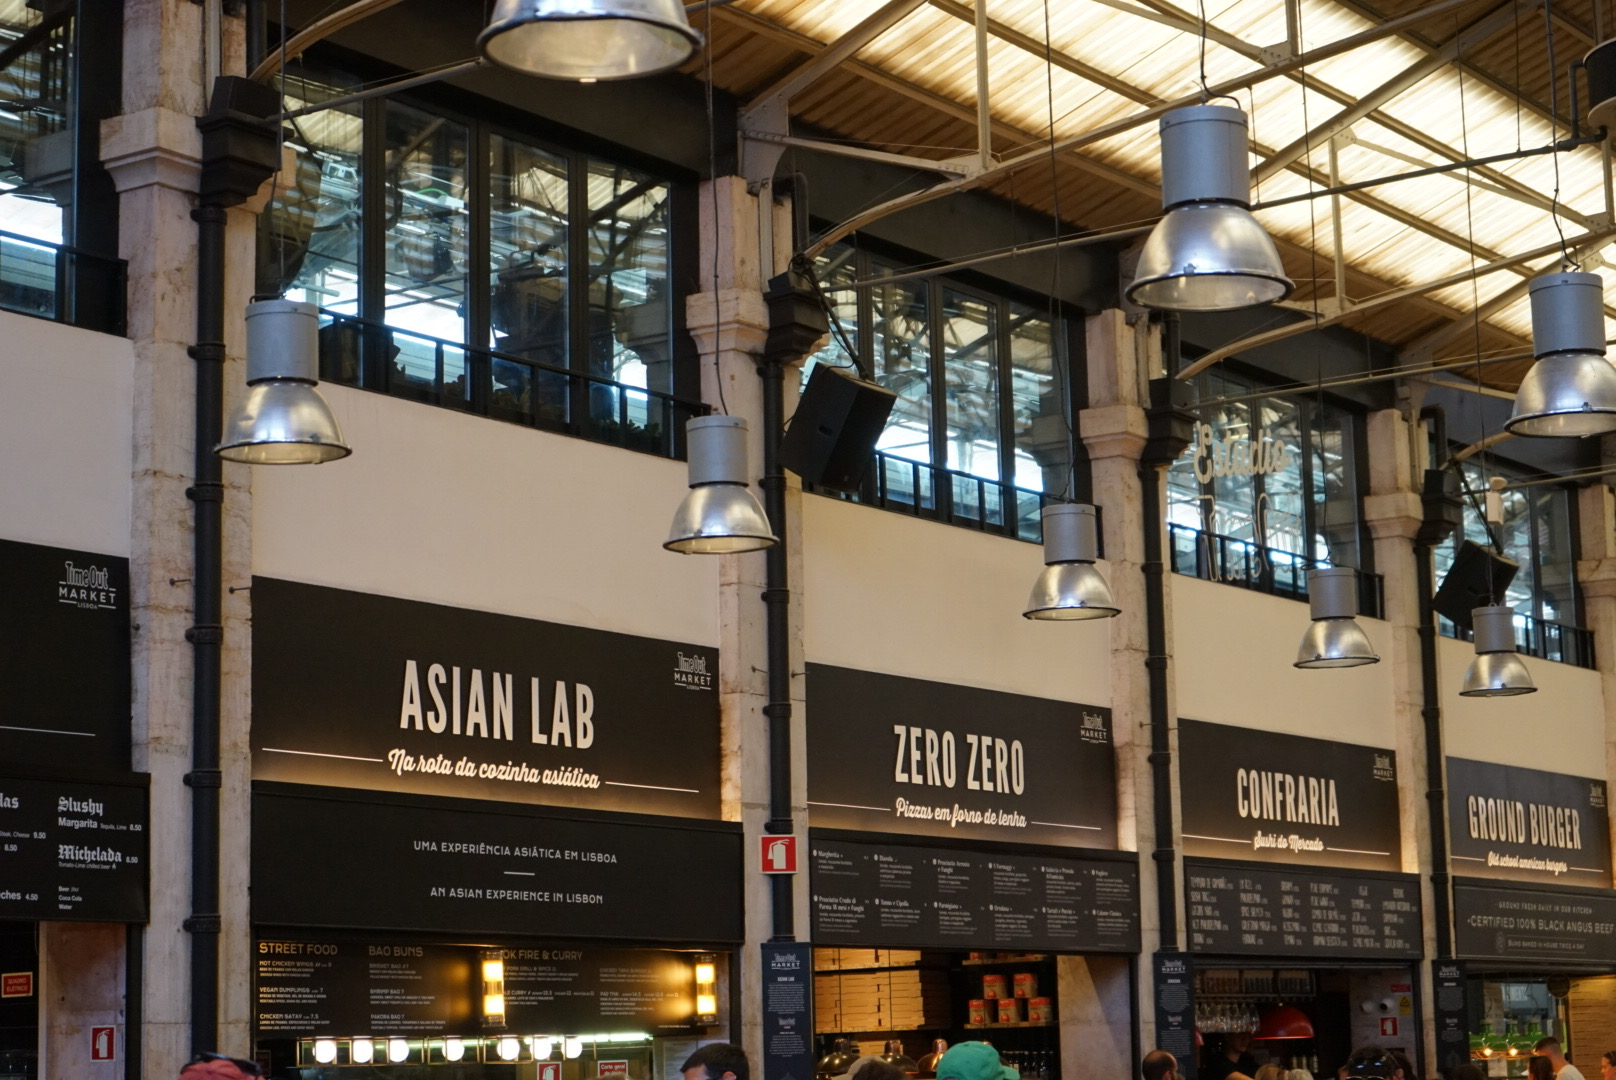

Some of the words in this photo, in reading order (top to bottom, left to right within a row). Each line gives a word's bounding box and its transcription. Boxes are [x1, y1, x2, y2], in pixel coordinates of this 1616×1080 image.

[59, 586, 116, 604] MARKET
[77, 602, 98, 610] LISBOA
[674, 672, 712, 686] MARKET
[400, 659, 514, 741] ASIAN
[531, 676, 595, 749] LAB
[1080, 729, 1107, 740] MARKET
[894, 724, 957, 788] ZERO
[966, 733, 1025, 796] ZERO
[388, 748, 416, 776] Na
[415, 754, 454, 775] rota
[454, 755, 477, 777] da
[478, 760, 541, 784] cozinha
[542, 766, 600, 789] asiática
[1373, 768, 1394, 778] MARKET
[1237, 767, 1340, 827] CONFRARIA
[58, 796, 103, 816] Slushy
[896, 797, 933, 820] Pizzas
[934, 807, 951, 821] em
[951, 803, 983, 828] forno
[983, 808, 997, 826] de
[998, 809, 1027, 828] lenha
[58, 816, 98, 830] Margarita
[129, 824, 142, 832] 8.50
[1467, 794, 1526, 844] GROUND
[1529, 803, 1582, 850] BURGER
[33, 831, 46, 840] 9.50
[1254, 830, 1277, 850] Sushi
[1278, 834, 1288, 849] do
[1288, 834, 1324, 853] Mercado
[4, 843, 17, 852] 8.50
[58, 844, 122, 863] Michelada
[126, 856, 139, 864] 8.50
[414, 840, 437, 851] UMA
[441, 842, 511, 856] EXPERIÊNCIA
[514, 846, 562, 860] ASIÁTICA
[564, 850, 578, 860] EM
[581, 851, 617, 864] LISBOA
[1487, 850, 1499, 867] Old
[1499, 853, 1519, 868] school
[1519, 858, 1546, 870] american
[1546, 858, 1568, 876] burgers
[25, 893, 38, 901] 4.50
[58, 894, 70, 902] Coca
[430, 886, 446, 897] AN
[449, 888, 483, 899] ASIAN
[486, 889, 550, 901] EXPERIENCE
[553, 892, 563, 902] IN
[566, 893, 603, 904] LISBON
[1498, 901, 1520, 910] GROUND
[1521, 903, 1536, 911] FRESH
[1538, 903, 1552, 911] DAILY
[1561, 904, 1571, 913] OUR
[1573, 905, 1593, 914] KITCHEN
[1516, 918, 1536, 929] 100%
[1538, 919, 1564, 931] BLACK
[1566, 921, 1593, 933] ANGUS
[1594, 922, 1615, 934] BEEF
[259, 942, 304, 954] STREET
[307, 944, 338, 955] FOOD
[368, 945, 391, 956] BAO
[393, 946, 423, 957] BUNS
[519, 949, 540, 960] FIRE
[542, 951, 550, 960] &
[552, 950, 583, 960] CURRY
